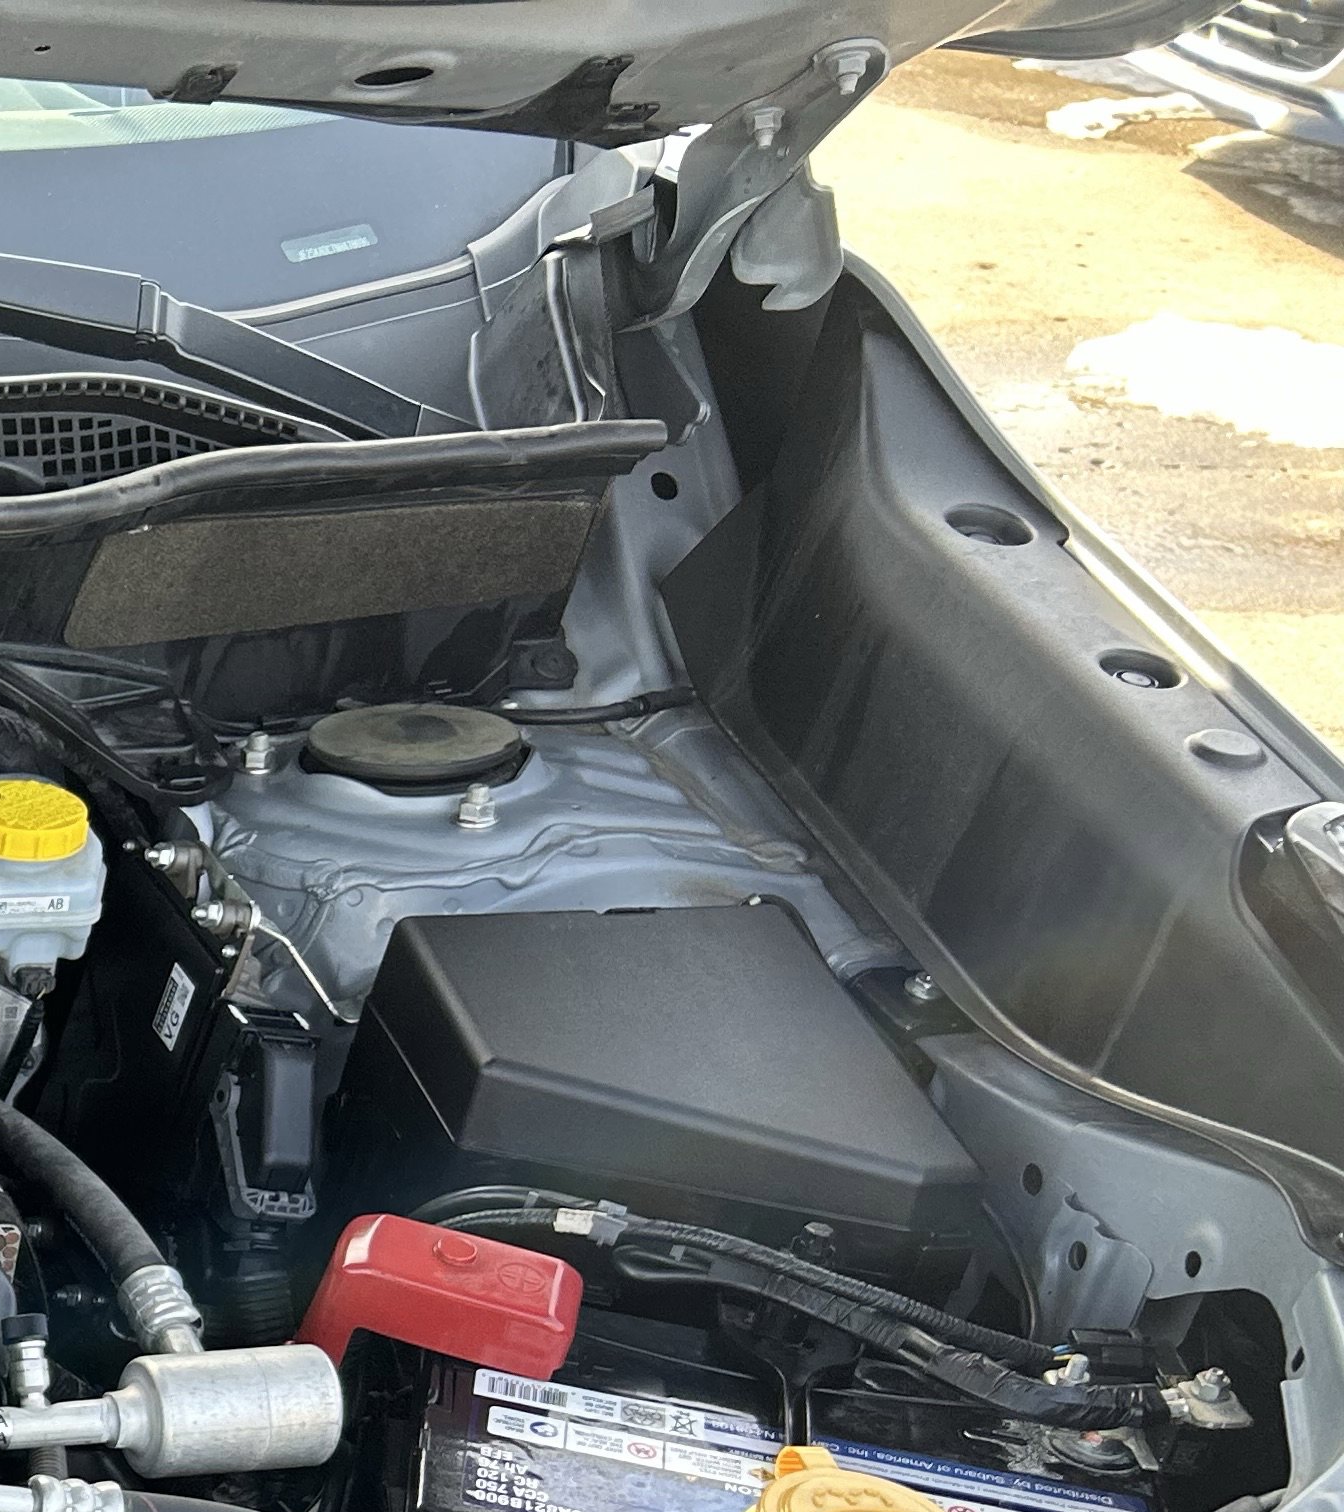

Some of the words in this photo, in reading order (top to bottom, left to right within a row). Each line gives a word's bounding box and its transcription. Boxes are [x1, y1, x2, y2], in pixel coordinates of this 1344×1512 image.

[46, 897, 64, 910] AB
[162, 1010, 181, 1039] VG
[479, 1445, 513, 1461] EFB
[871, 1451, 933, 1469] America,
[476, 1466, 509, 1482] 120
[503, 1461, 528, 1475] Ah
[937, 1464, 951, 1473] of
[954, 1467, 1006, 1484] Subaru
[474, 1477, 509, 1493] 750
[512, 1474, 539, 1488] RC
[511, 1485, 549, 1502] CCA
[1034, 1483, 1113, 1503] Distributed
